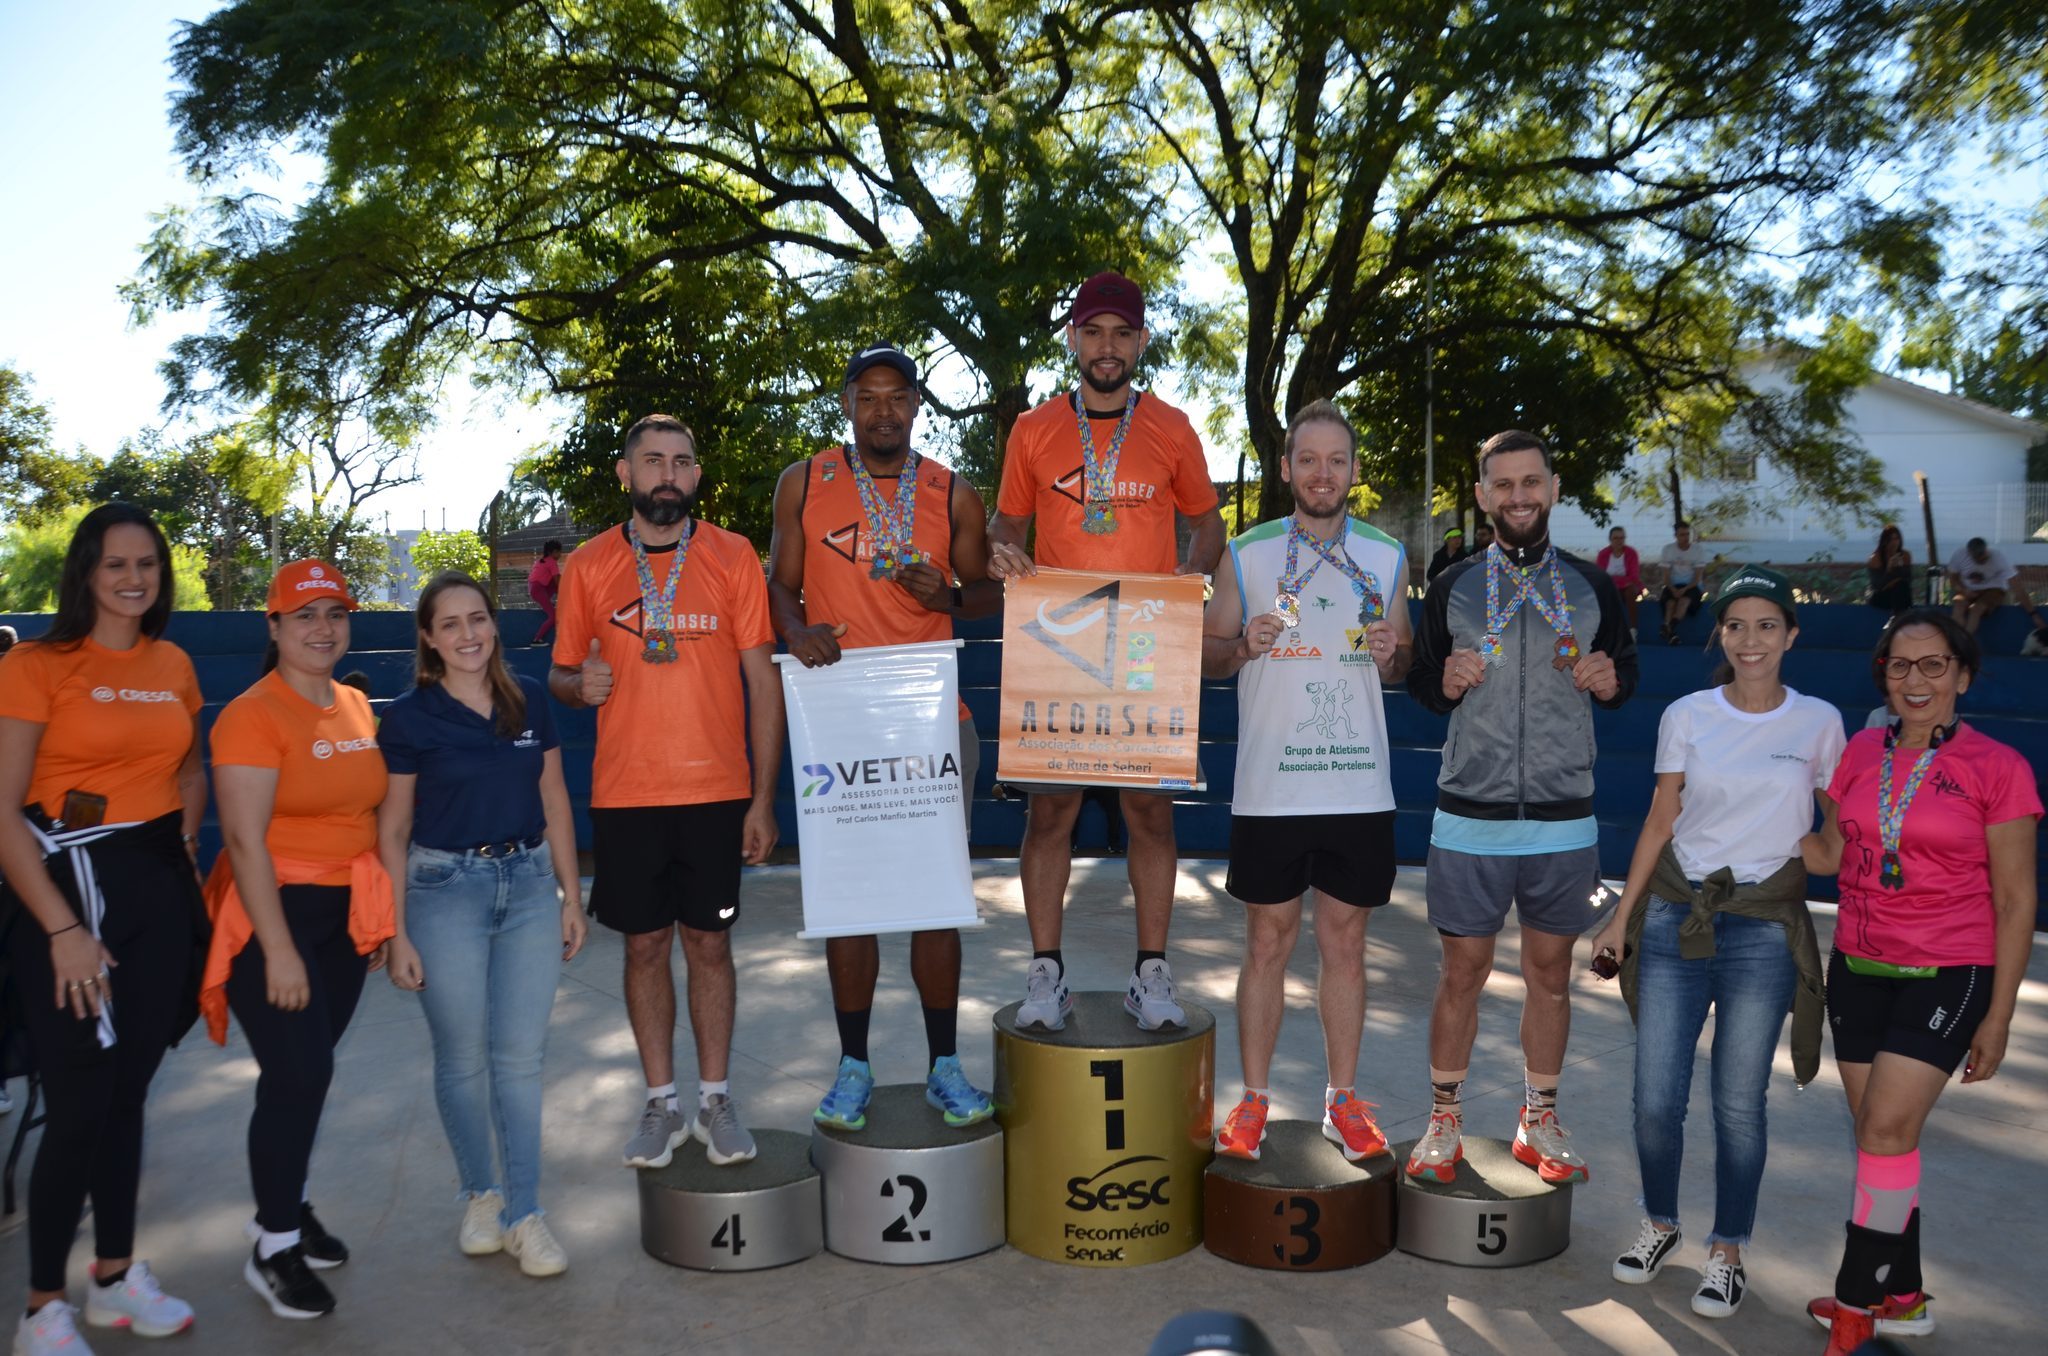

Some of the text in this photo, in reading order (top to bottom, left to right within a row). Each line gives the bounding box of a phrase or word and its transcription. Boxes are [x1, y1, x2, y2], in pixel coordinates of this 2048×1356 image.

[1270, 646, 1322, 657] ZACA
[1021, 701, 1184, 737] ACORSEB
[1018, 737, 1084, 753] Associação
[1285, 744, 1370, 758] Grupo de Atletismo
[836, 753, 959, 786] VETRIA
[1047, 758, 1062, 770] de
[1067, 759, 1090, 770] Rua
[1093, 760, 1109, 772] de
[1278, 760, 1376, 773] Associação Portelense
[841, 783, 959, 800] ASSESSORIA DE CORRIDA
[804, 806, 825, 815] MAIS
[860, 802, 882, 811] MAIS
[910, 798, 932, 806] MAIS
[837, 809, 938, 825] Prof Carlos Manfio Martins
[1090, 1059, 1125, 1150] 1
[1065, 1173, 1170, 1212] Sesc
[880, 1174, 931, 1242] 2
[711, 1213, 746, 1255] 4
[1064, 1219, 1170, 1241] Fecomércio
[1273, 1196, 1322, 1266] 3
[1476, 1213, 1507, 1256] 5
[1065, 1245, 1123, 1261] Senac
